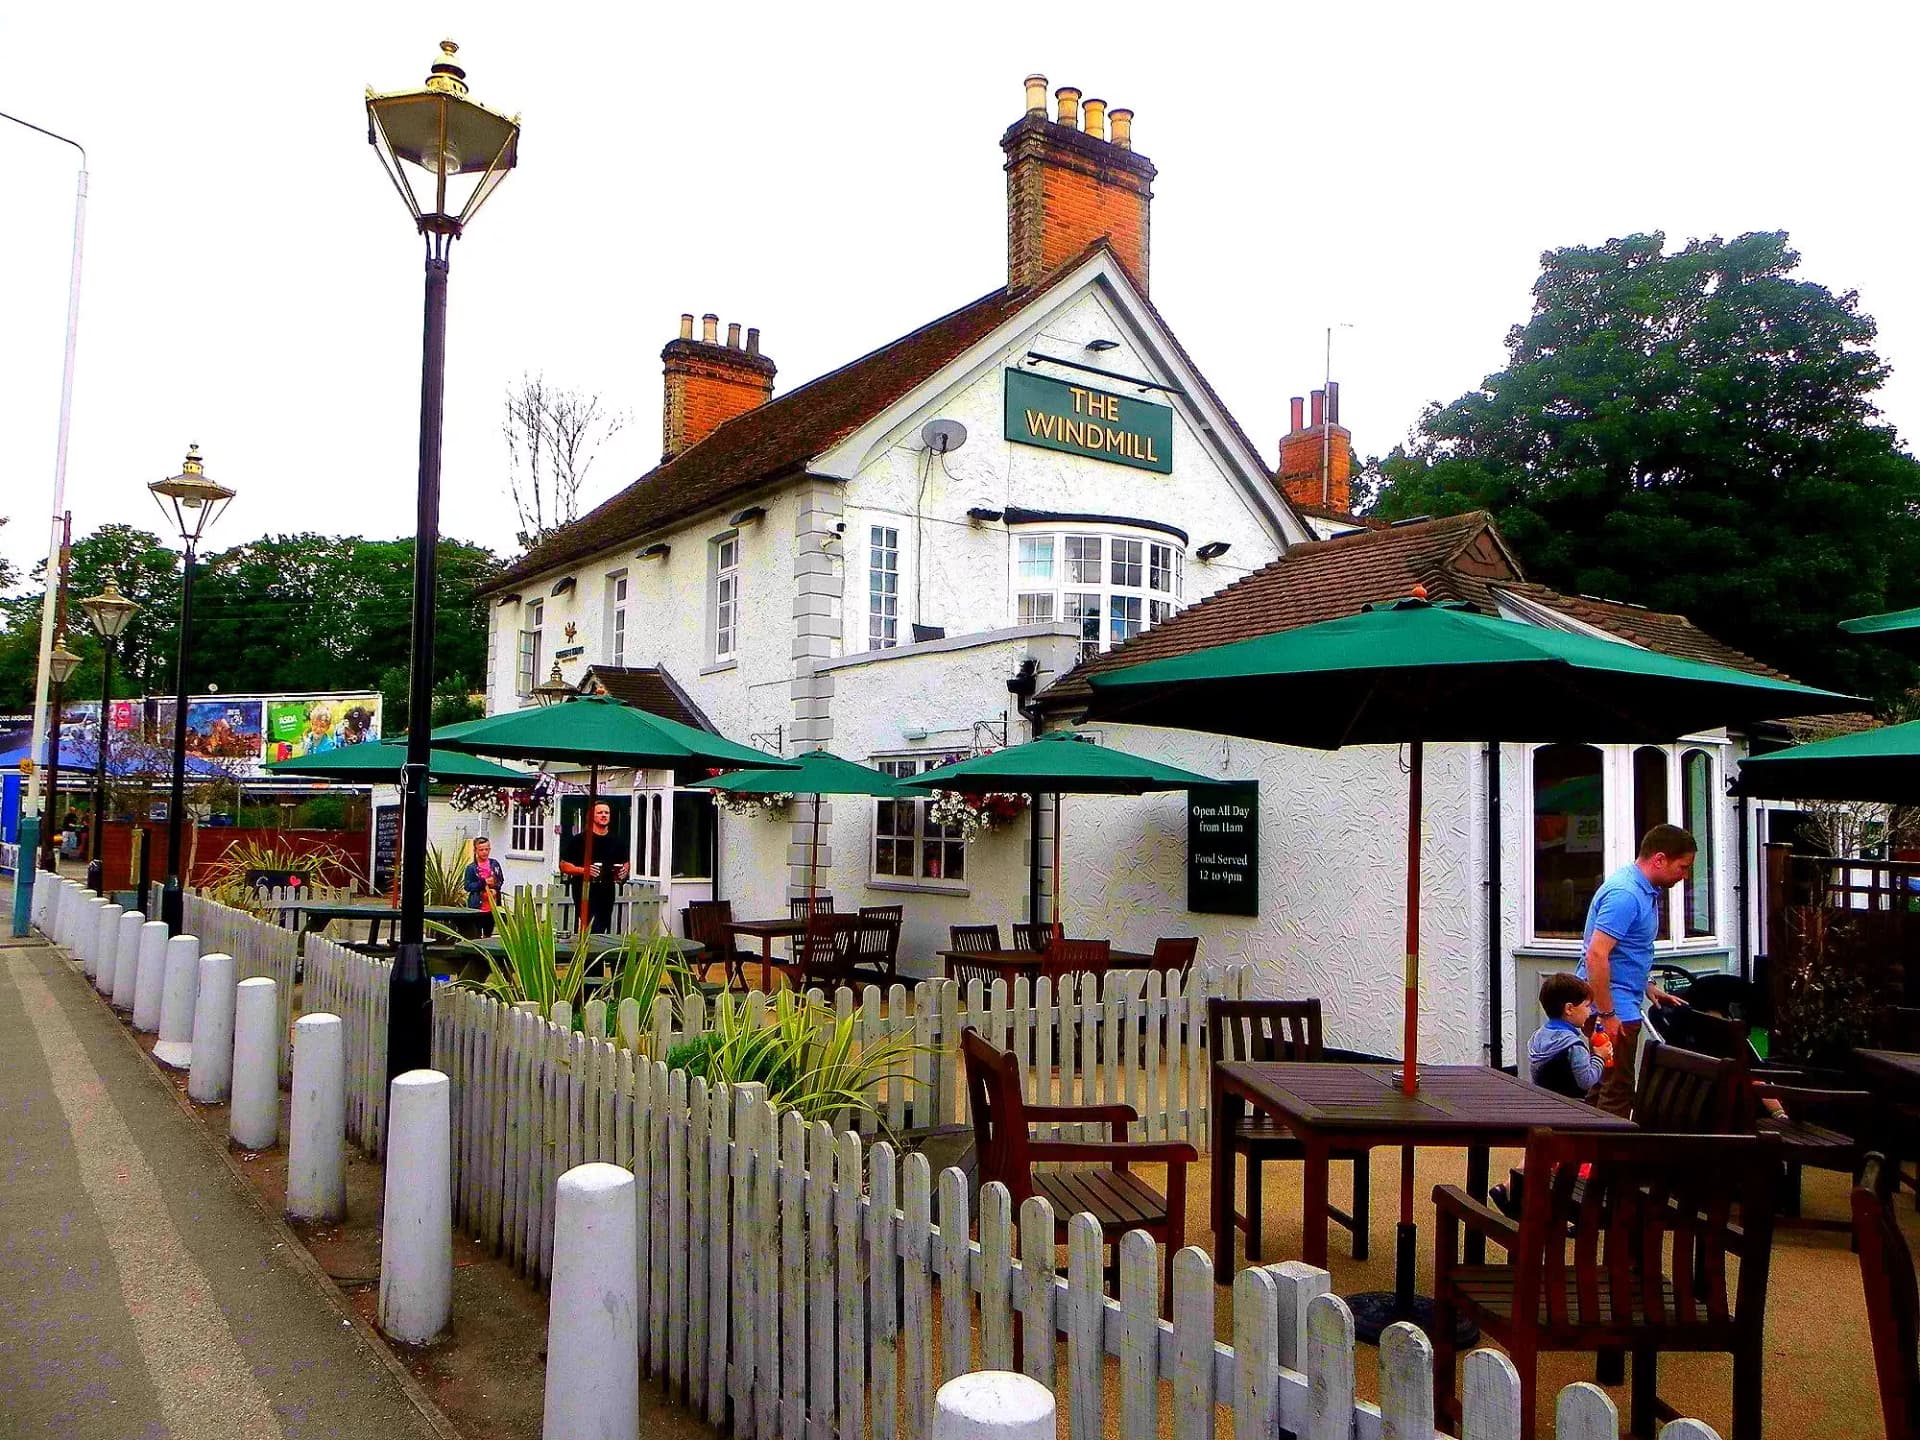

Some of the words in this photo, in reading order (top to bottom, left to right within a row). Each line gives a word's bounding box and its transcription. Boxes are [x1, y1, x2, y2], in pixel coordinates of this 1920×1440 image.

[1069, 387, 1120, 421] THE
[1025, 409, 1158, 462] WINDMILL
[1193, 806, 1216, 819] Open
[1217, 805, 1230, 816] All
[1232, 806, 1250, 819] Day
[1199, 821, 1219, 832] from
[1222, 822, 1243, 832] 11am
[1195, 853, 1216, 864] Food
[1218, 854, 1248, 865] Served
[1199, 870, 1209, 880] 12
[1212, 871, 1220, 881] to
[1223, 871, 1242, 884] 9pm
